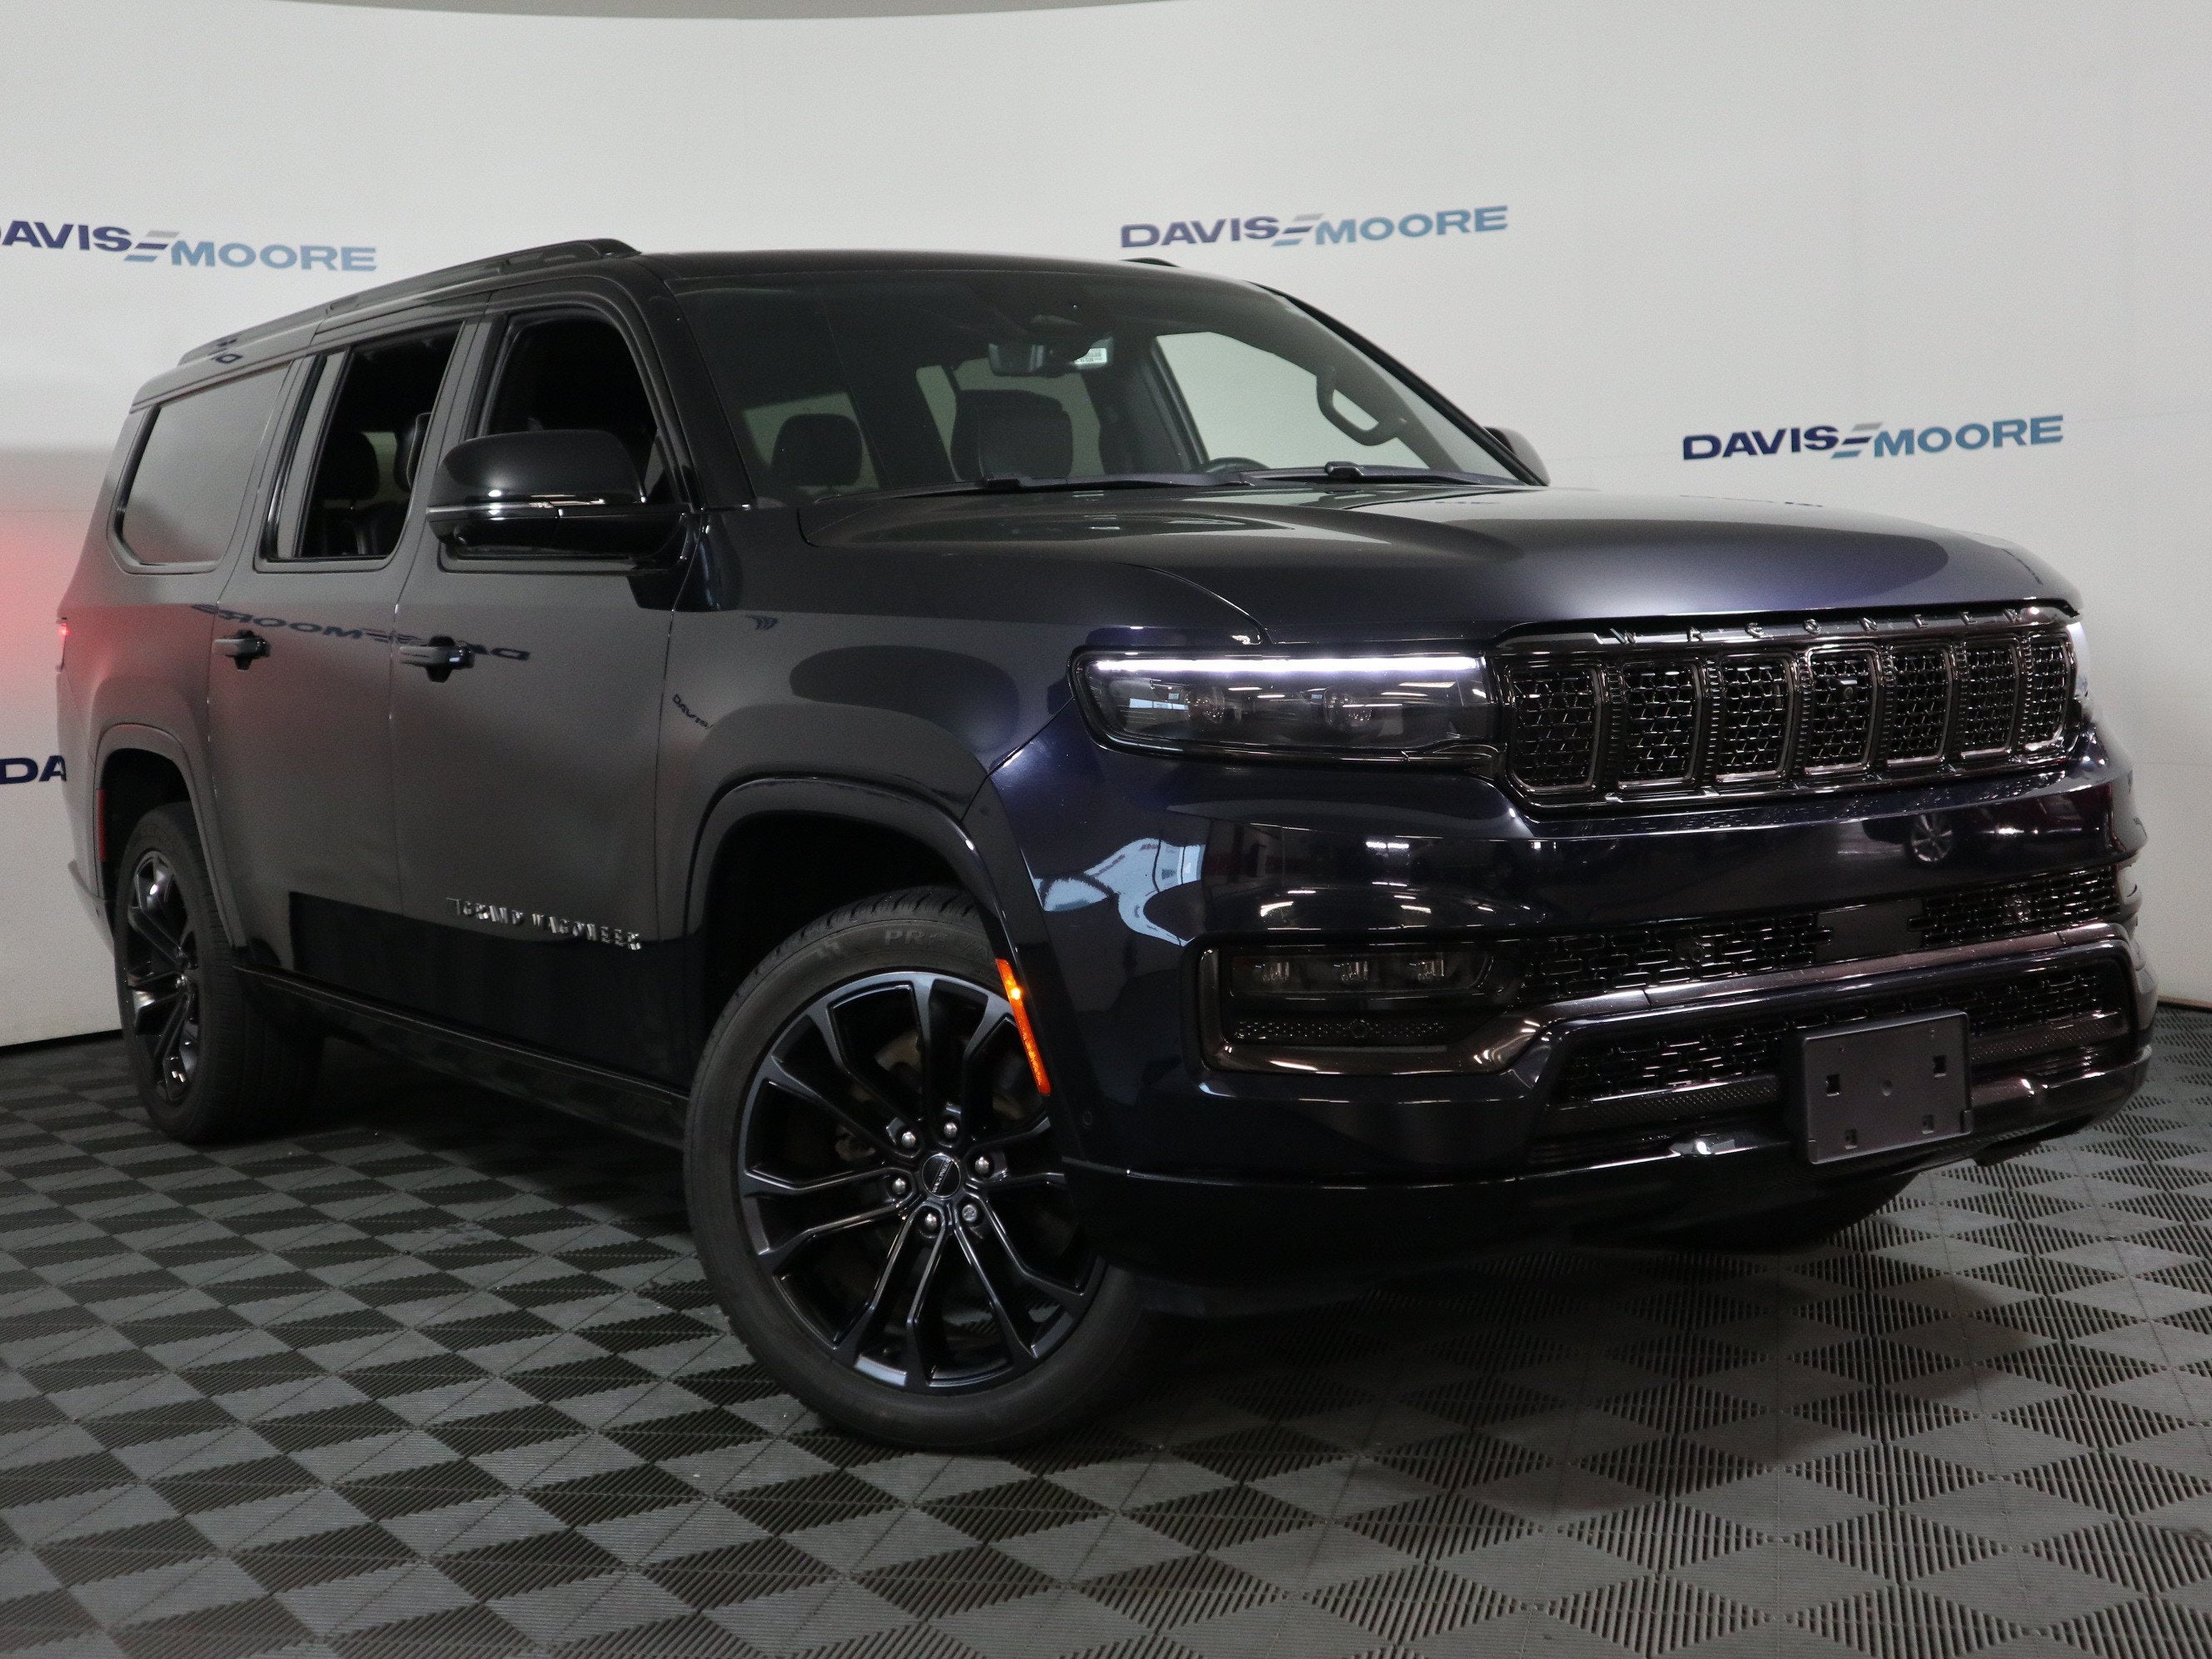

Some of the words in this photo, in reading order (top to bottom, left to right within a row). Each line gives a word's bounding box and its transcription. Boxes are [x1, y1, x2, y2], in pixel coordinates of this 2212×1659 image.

[0, 219, 132, 252] AVIS
[171, 240, 377, 271] MOORE
[1120, 216, 1280, 247] DAVIS
[1315, 205, 1508, 245] MOORE
[1682, 425, 1839, 460] DAVIS
[1873, 415, 2064, 457] MOORE
